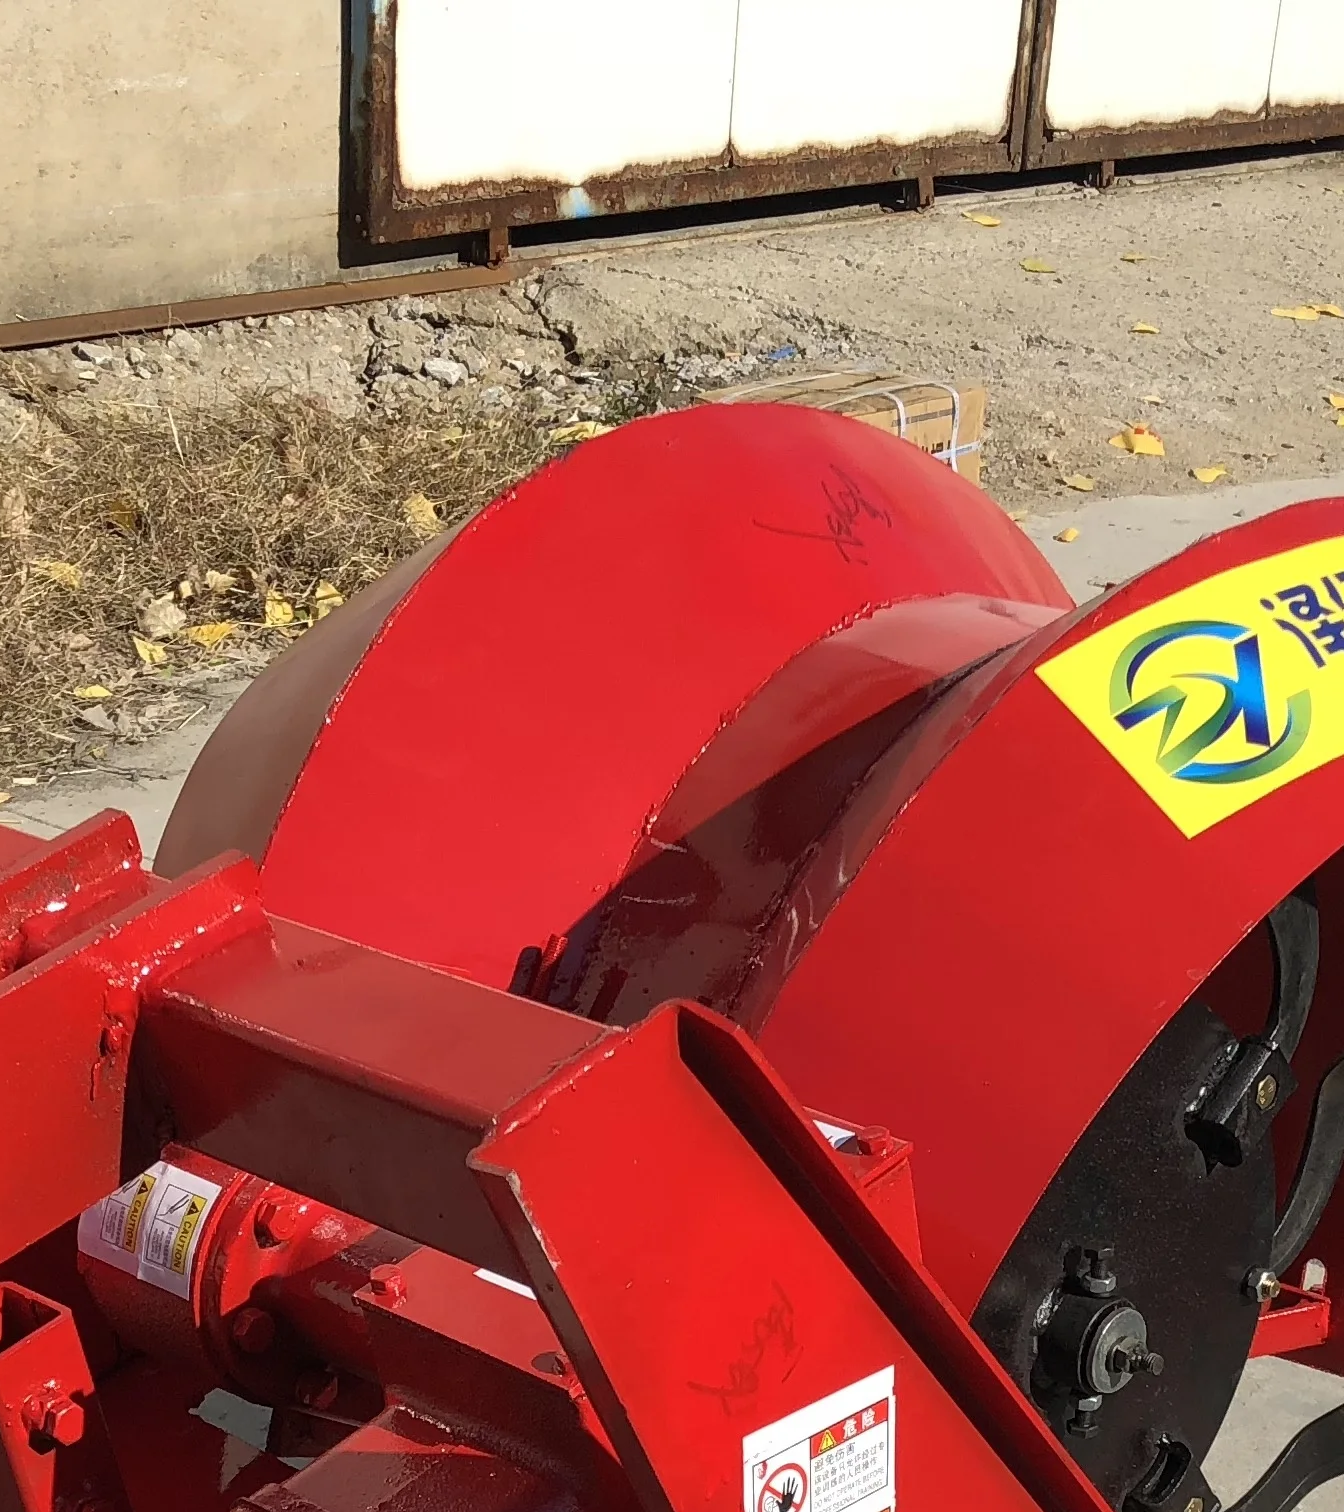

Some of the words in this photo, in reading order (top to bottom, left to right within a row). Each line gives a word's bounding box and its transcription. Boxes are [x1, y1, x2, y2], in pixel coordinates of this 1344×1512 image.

[126, 1199, 142, 1247] CAUTION
[174, 1221, 192, 1268] CAUTION
[843, 1407, 875, 1440] 危险
